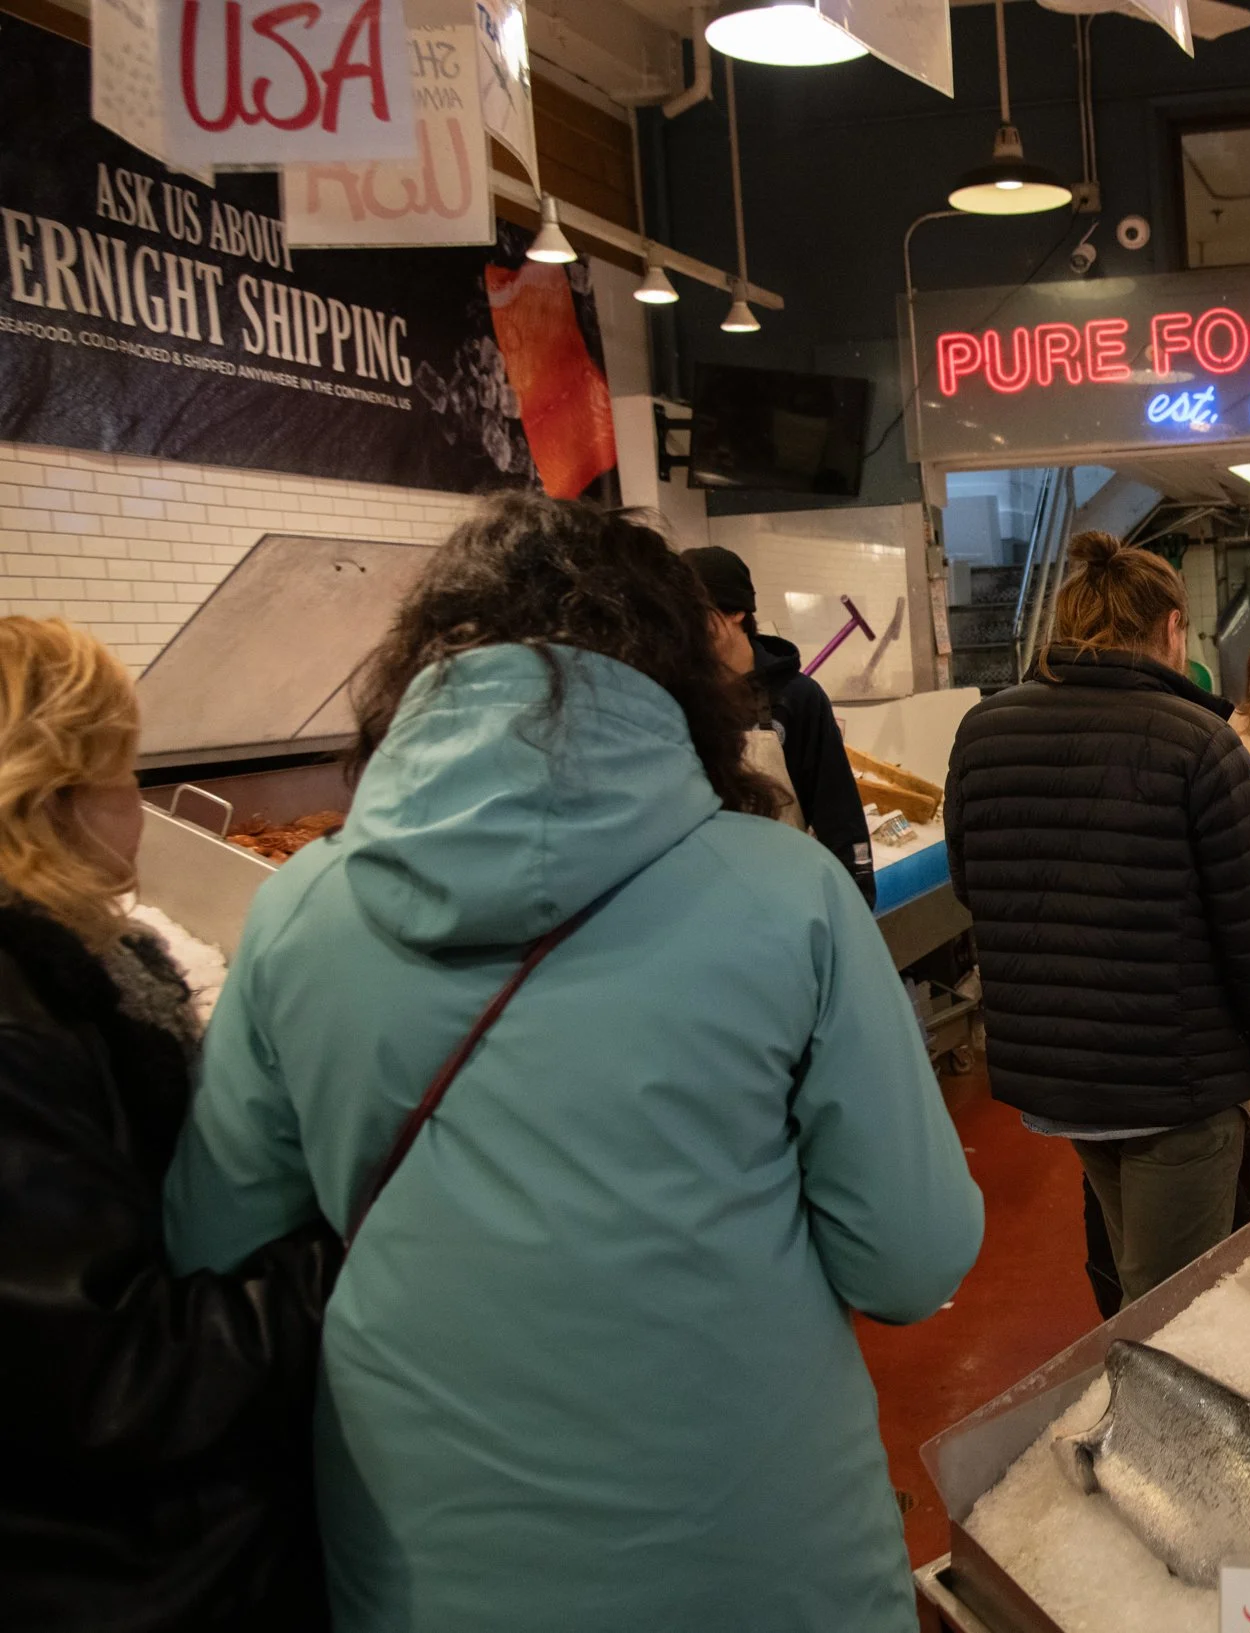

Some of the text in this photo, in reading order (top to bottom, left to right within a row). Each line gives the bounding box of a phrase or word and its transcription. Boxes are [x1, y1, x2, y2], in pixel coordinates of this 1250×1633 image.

[180, 0, 391, 134] USA
[97, 162, 294, 273] ASK US ABOUT
[1, 206, 413, 388] ERNIGHT SHIPPING
[171, 351, 182, 366] &
[183, 352, 236, 376] SHIPPED
[237, 364, 301, 388] ANYWHERE
[313, 378, 335, 396] THE
[334, 383, 400, 408] CONTINENTAL
[936, 316, 1132, 396] PURE
[1147, 384, 1219, 424] est.
